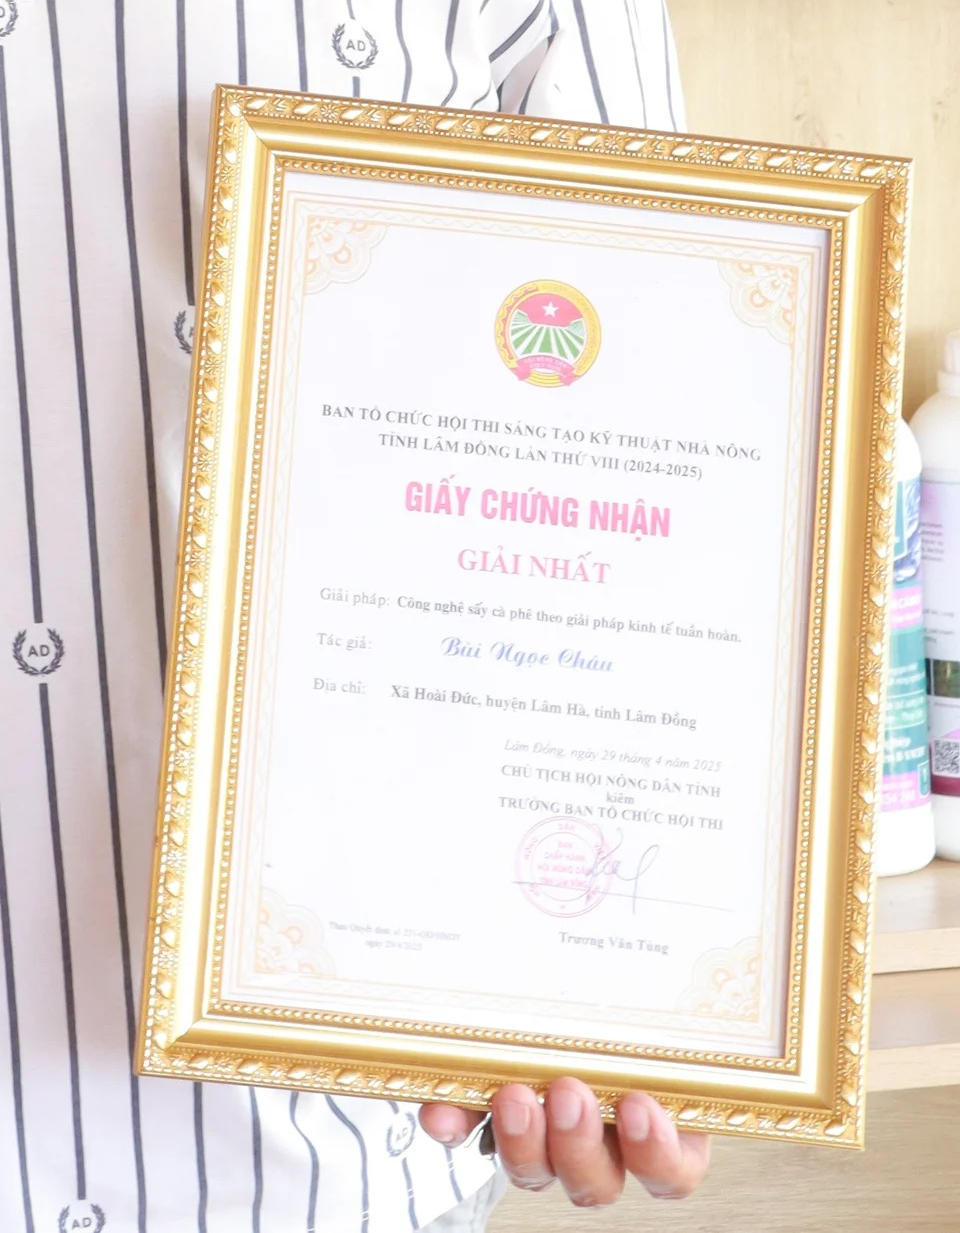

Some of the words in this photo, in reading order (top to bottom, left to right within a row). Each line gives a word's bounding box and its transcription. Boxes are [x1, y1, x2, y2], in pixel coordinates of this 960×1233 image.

[346, 39, 366, 51] AD
[322, 404, 354, 418] BAN
[359, 406, 381, 421] TỔ
[385, 410, 432, 426] CHỨC
[437, 415, 467, 431] HỘI
[471, 419, 499, 433] THI
[504, 420, 546, 438] SÁNG
[551, 427, 584, 443] TẠO
[589, 430, 612, 445] KỸ
[616, 434, 672, 452] THUẬT
[677, 440, 709, 455] NHÀ
[716, 443, 760, 460] NÔNG
[378, 431, 418, 448] TỈNH
[423, 436, 459, 453] LÂM
[464, 440, 509, 458] ĐỒNG
[515, 446, 546, 461] LẦN
[551, 451, 587, 466] THỨ
[590, 455, 619, 470] VIII
[623, 459, 702, 480] (2024-2025)
[405, 475, 471, 516] GIẤY
[480, 487, 579, 528] CHỨNG
[589, 498, 670, 541] NHẬN
[457, 545, 521, 575] GIẢI
[529, 552, 611, 583] NHẤT
[320, 587, 348, 602] Giải
[352, 592, 389, 608] pháp:
[397, 595, 430, 613] Công
[433, 600, 464, 617] nghệ
[467, 601, 488, 618] sấy
[491, 606, 505, 617] cà
[509, 608, 532, 621] phê
[536, 610, 563, 623] theo
[566, 613, 589, 627] giải
[592, 616, 624, 633] pháp
[628, 619, 656, 633] kinh
[660, 621, 674, 635] tế
[675, 623, 703, 638] tuần
[707, 628, 741, 642] hoàn.
[27, 644, 50, 657] AD
[316, 632, 342, 646] Tác
[345, 635, 371, 651] giả:
[441, 636, 481, 658] Bùi
[489, 642, 549, 667] Ngọc
[558, 648, 612, 671] Châu
[313, 677, 336, 693] Địa
[390, 684, 409, 698] Xã
[414, 687, 446, 702] Hoài
[450, 690, 481, 707] Đức,
[485, 694, 526, 712] huyện
[530, 699, 561, 713] Lâm
[566, 703, 590, 717] Hà,
[625, 708, 656, 723] Lâm
[661, 711, 696, 731] Đồng
[501, 764, 532, 778] CHỦ
[535, 768, 571, 782] TỊCH
[575, 772, 601, 787] HỘI
[606, 773, 648, 790] NÔNG
[652, 778, 681, 793] DÂN
[685, 782, 720, 797] TỈNH
[498, 795, 561, 814] TRƯỞNG
[563, 803, 593, 818] BAN
[597, 805, 617, 819] TỔ
[621, 808, 663, 824] CHỨC
[668, 814, 694, 828] HỘI
[698, 817, 723, 830] THI
[72, 1217, 92, 1230] AD
